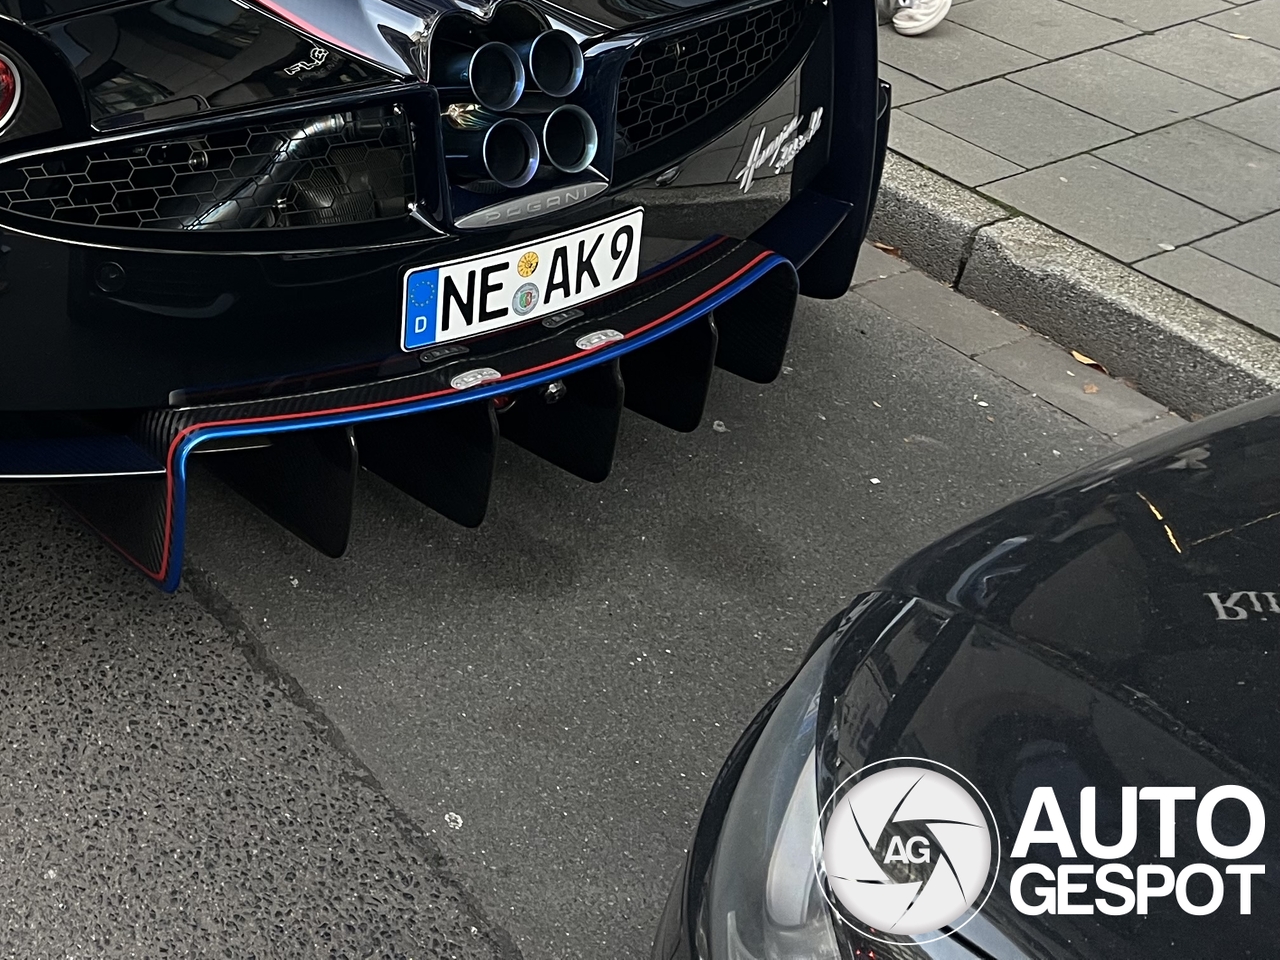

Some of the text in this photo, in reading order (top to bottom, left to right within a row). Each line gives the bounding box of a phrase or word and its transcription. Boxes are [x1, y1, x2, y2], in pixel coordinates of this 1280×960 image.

[485, 187, 588, 224] PAGANI
[441, 261, 510, 332] NE
[414, 316, 427, 333] D
